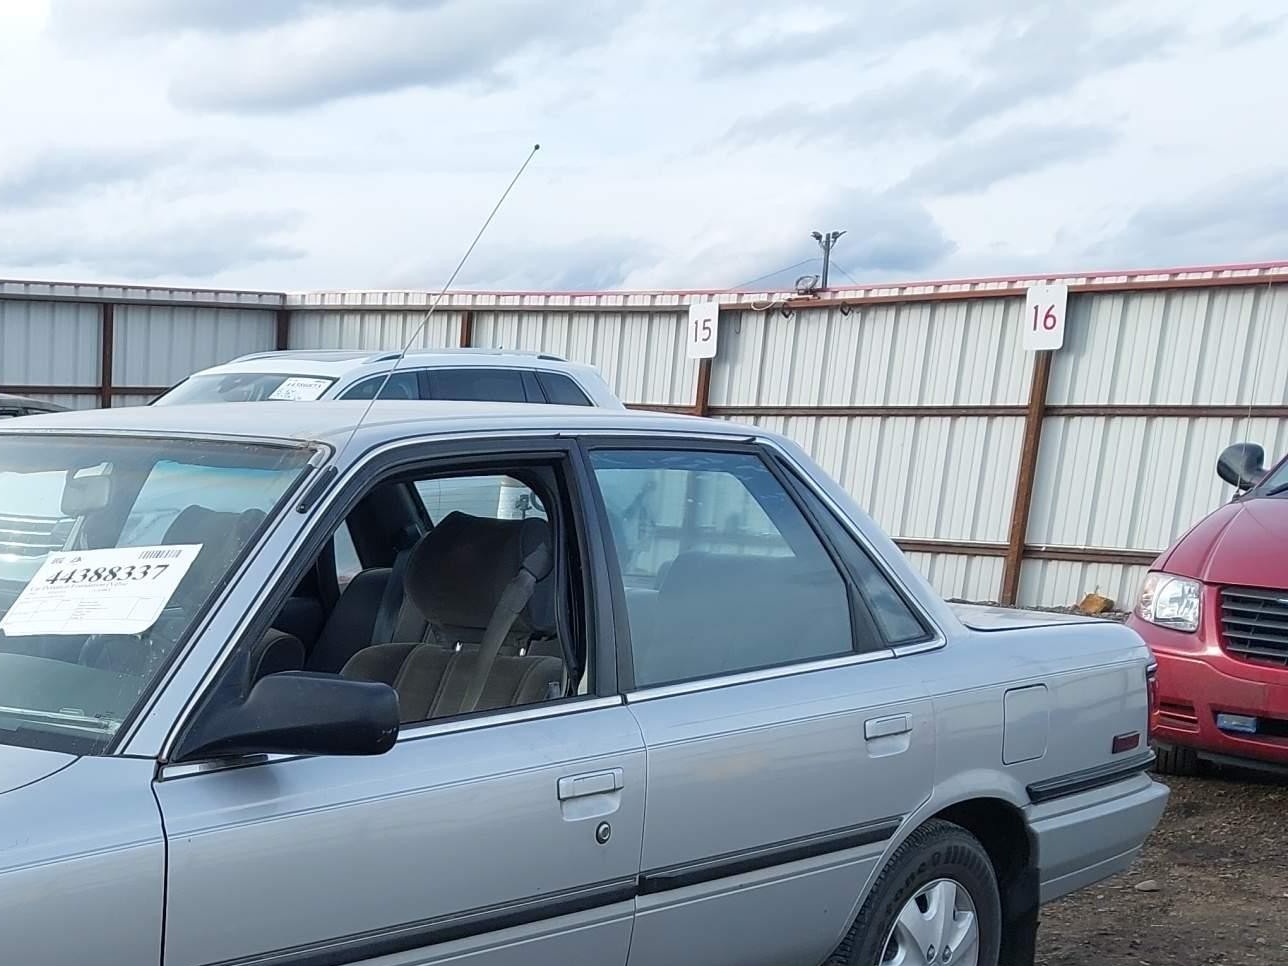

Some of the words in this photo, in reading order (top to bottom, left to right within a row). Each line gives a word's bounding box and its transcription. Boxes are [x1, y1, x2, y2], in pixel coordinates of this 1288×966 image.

[1032, 303, 1057, 332] 16
[693, 318, 712, 343] 15
[44, 563, 170, 585] 44388337
